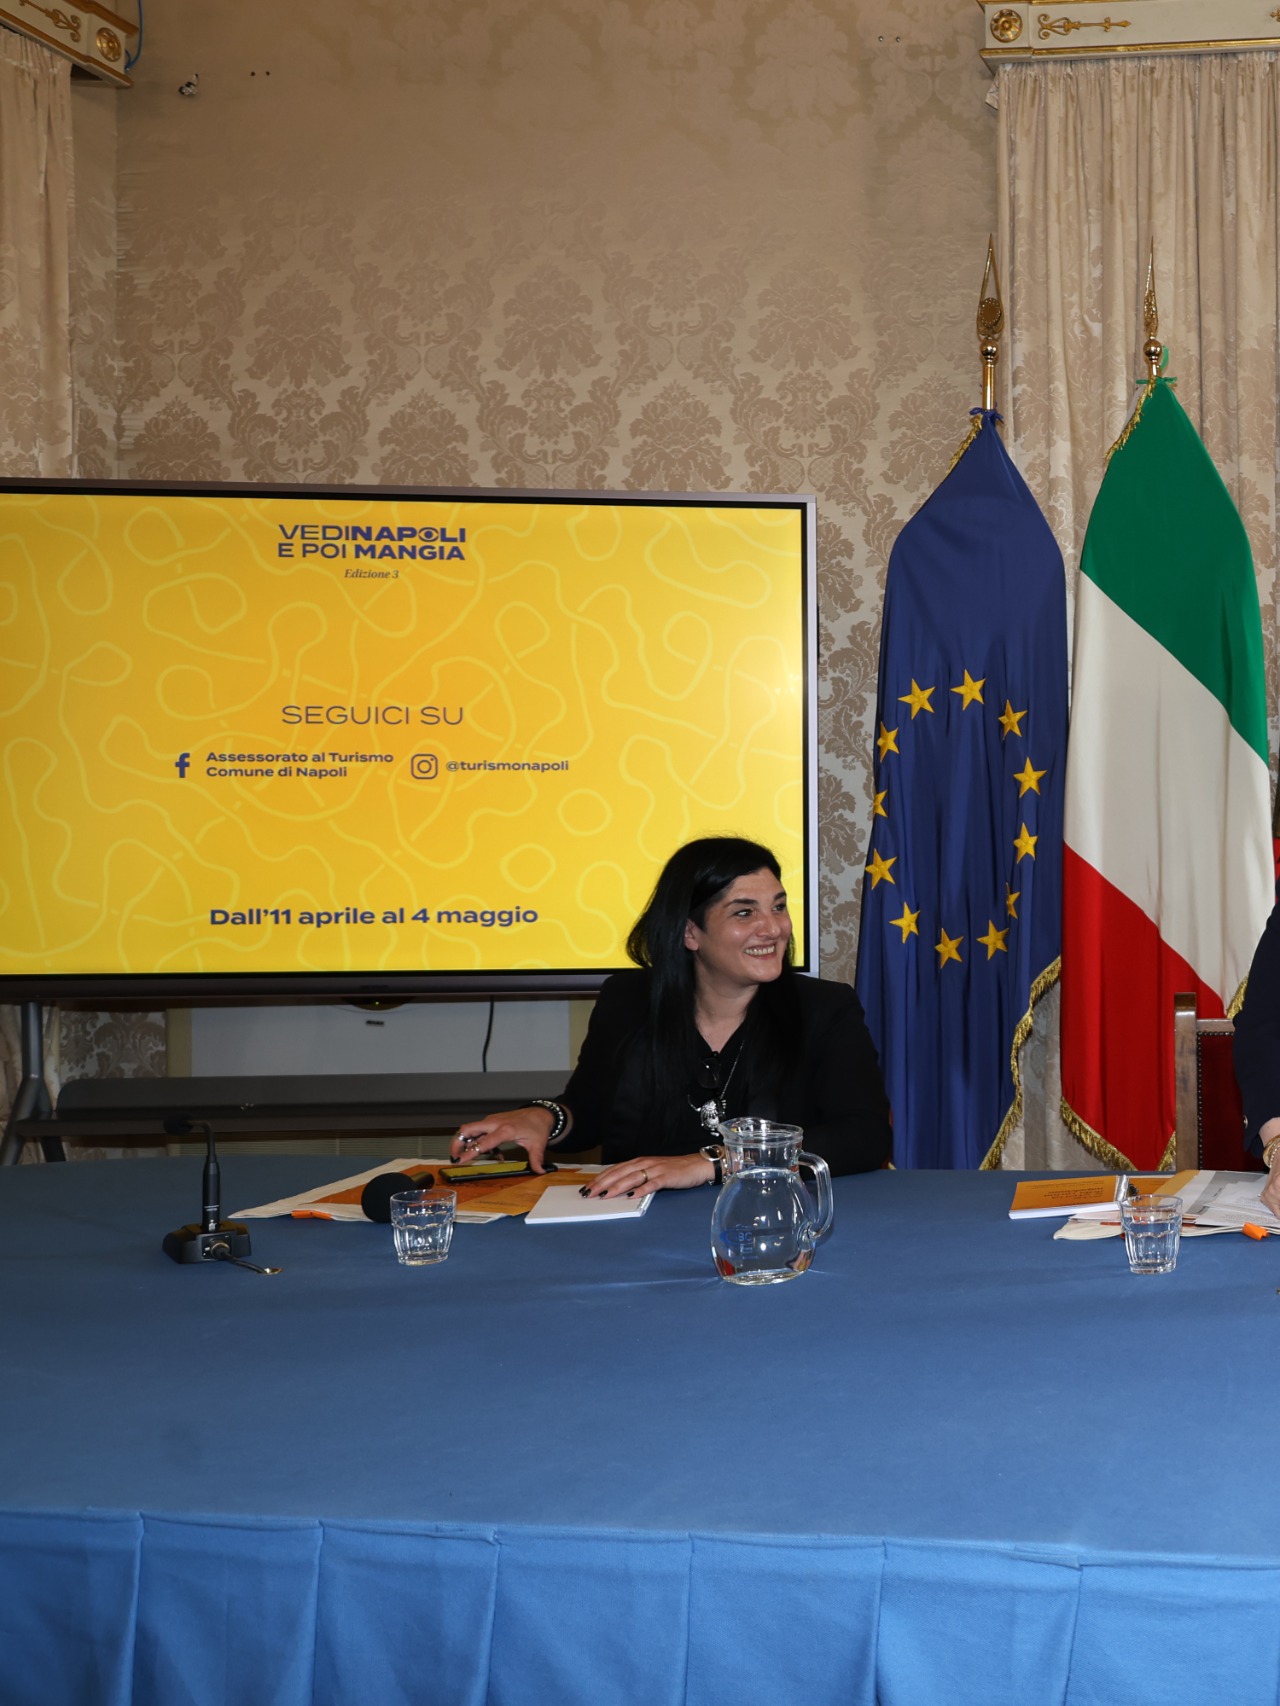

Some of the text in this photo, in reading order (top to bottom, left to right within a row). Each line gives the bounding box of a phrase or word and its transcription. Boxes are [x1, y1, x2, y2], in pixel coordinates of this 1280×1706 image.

[277, 543, 466, 560] E POI MANGIA
[344, 569, 399, 579] Edizione 3
[281, 705, 464, 725] SEGUICI SU
[206, 752, 394, 763] Assessorato al Turismo
[206, 766, 347, 780] Comune di Napoli
[446, 759, 569, 774] @turismonapoli
[298, 908, 375, 928] aprile
[382, 908, 404, 923] al
[411, 909, 430, 923] 4
[436, 906, 538, 927] maggio
